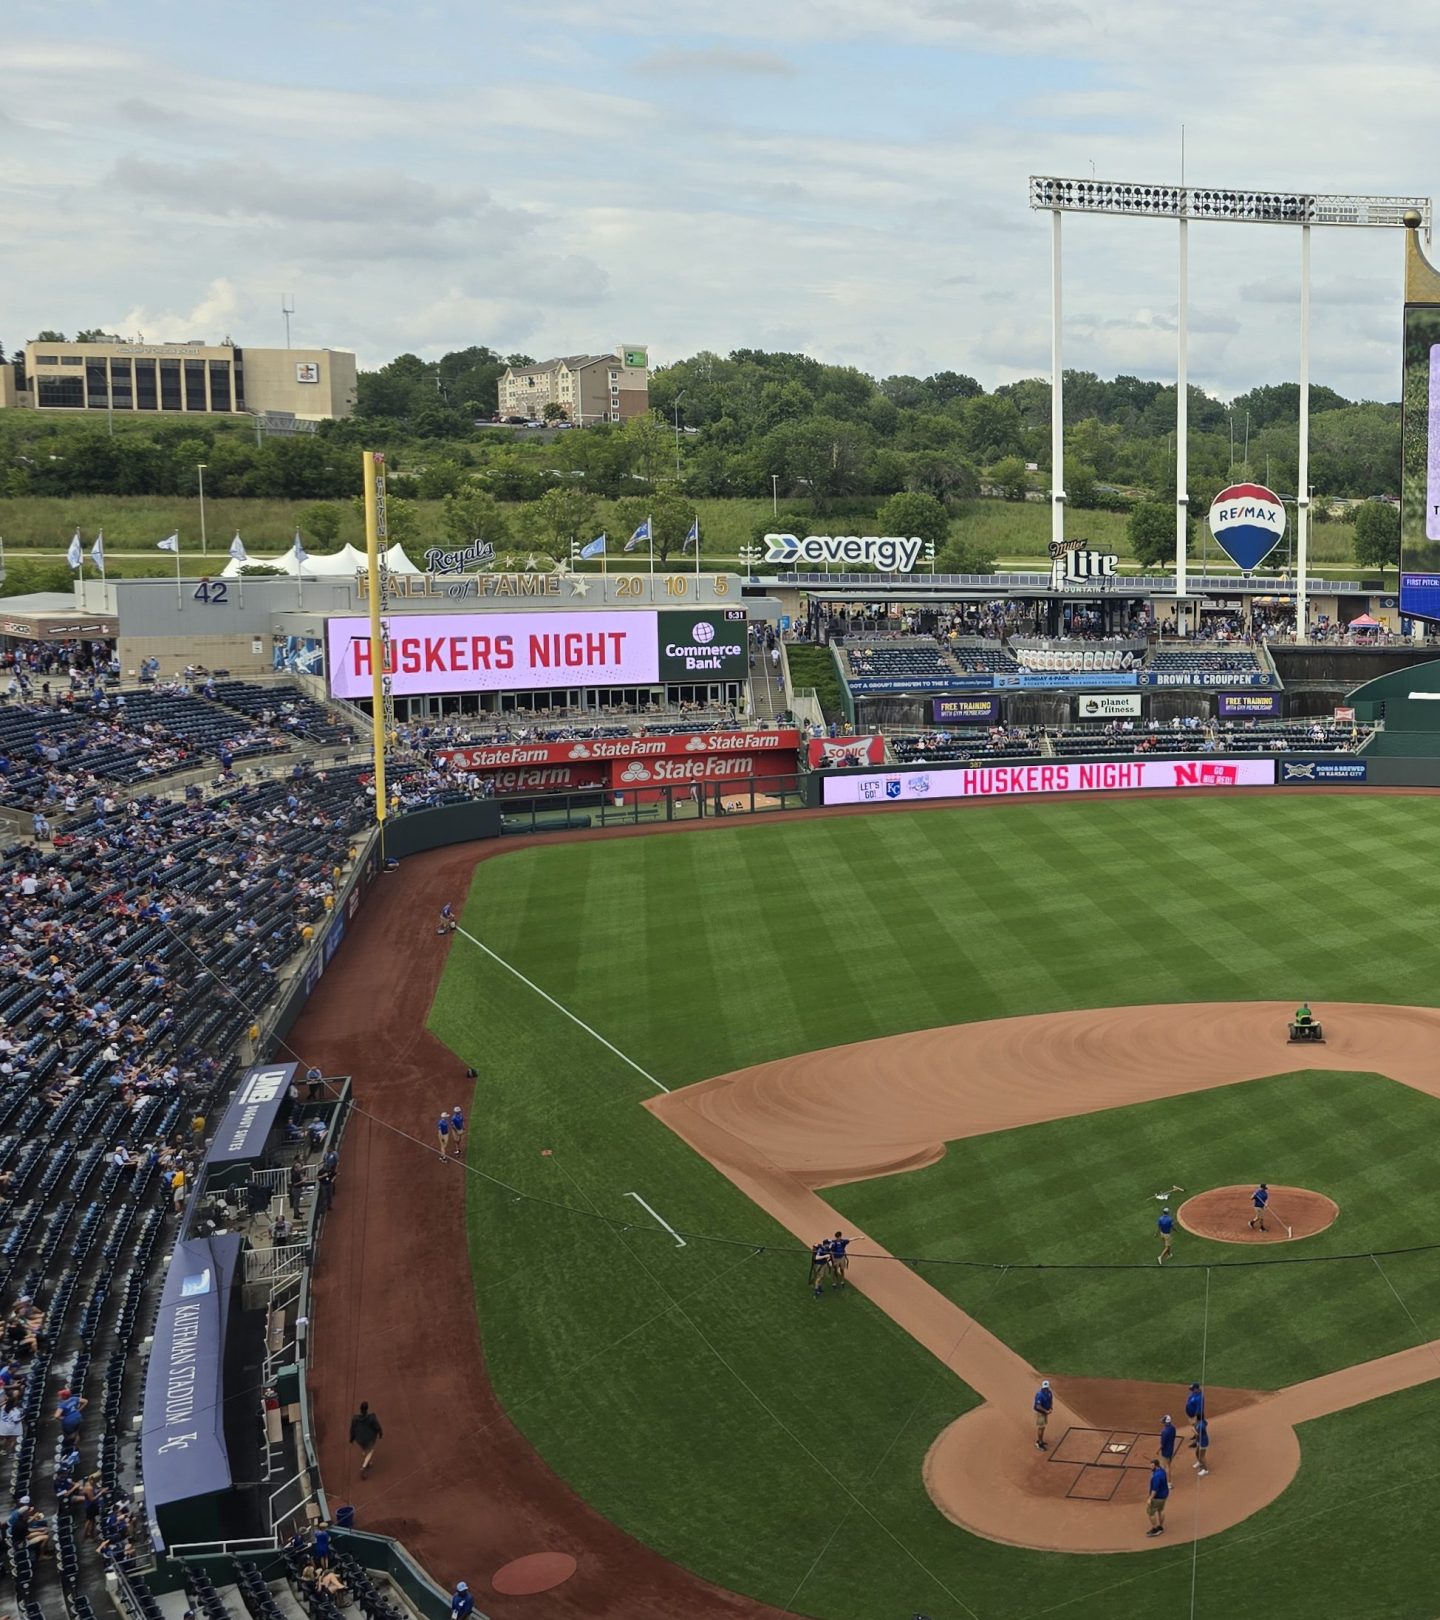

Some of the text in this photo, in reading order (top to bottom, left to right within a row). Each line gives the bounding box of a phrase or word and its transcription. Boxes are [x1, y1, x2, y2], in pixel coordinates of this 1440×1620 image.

[1217, 505, 1277, 525] RE/MAX
[424, 538, 496, 574] Royals
[803, 538, 919, 571] evergy
[1048, 538, 1088, 559] Miller
[1064, 548, 1119, 584] Lite
[447, 575, 471, 603] of
[476, 574, 561, 598] FAME
[615, 575, 643, 597] 20
[663, 575, 687, 597] 10
[713, 576, 729, 597] 5
[1406, 578, 1422, 586] FIRST
[193, 582, 228, 603] 42
[354, 631, 627, 675] HUSKERS NIGHT
[665, 643, 742, 657] Commerce
[686, 656, 722, 670] Bank
[1157, 674, 1252, 685] BROWN & CROUPPEN
[940, 701, 991, 711] FREE TRAINING
[1100, 698, 1129, 707] planet
[1104, 705, 1135, 713] fitness
[1225, 697, 1273, 705] FREE TRAINING
[828, 746, 866, 759] SONIC
[963, 765, 1070, 796] HUSKERS
[1079, 763, 1146, 789] NIGHT
[1173, 763, 1199, 787] N
[1203, 774, 1215, 784] BIG
[1214, 766, 1224, 775] GO
[860, 781, 880, 791] LET'S
[887, 782, 900, 795] KC
[247, 1070, 287, 1104] UMB
[165, 1303, 201, 1426] KAUFFMAN STADIUM
